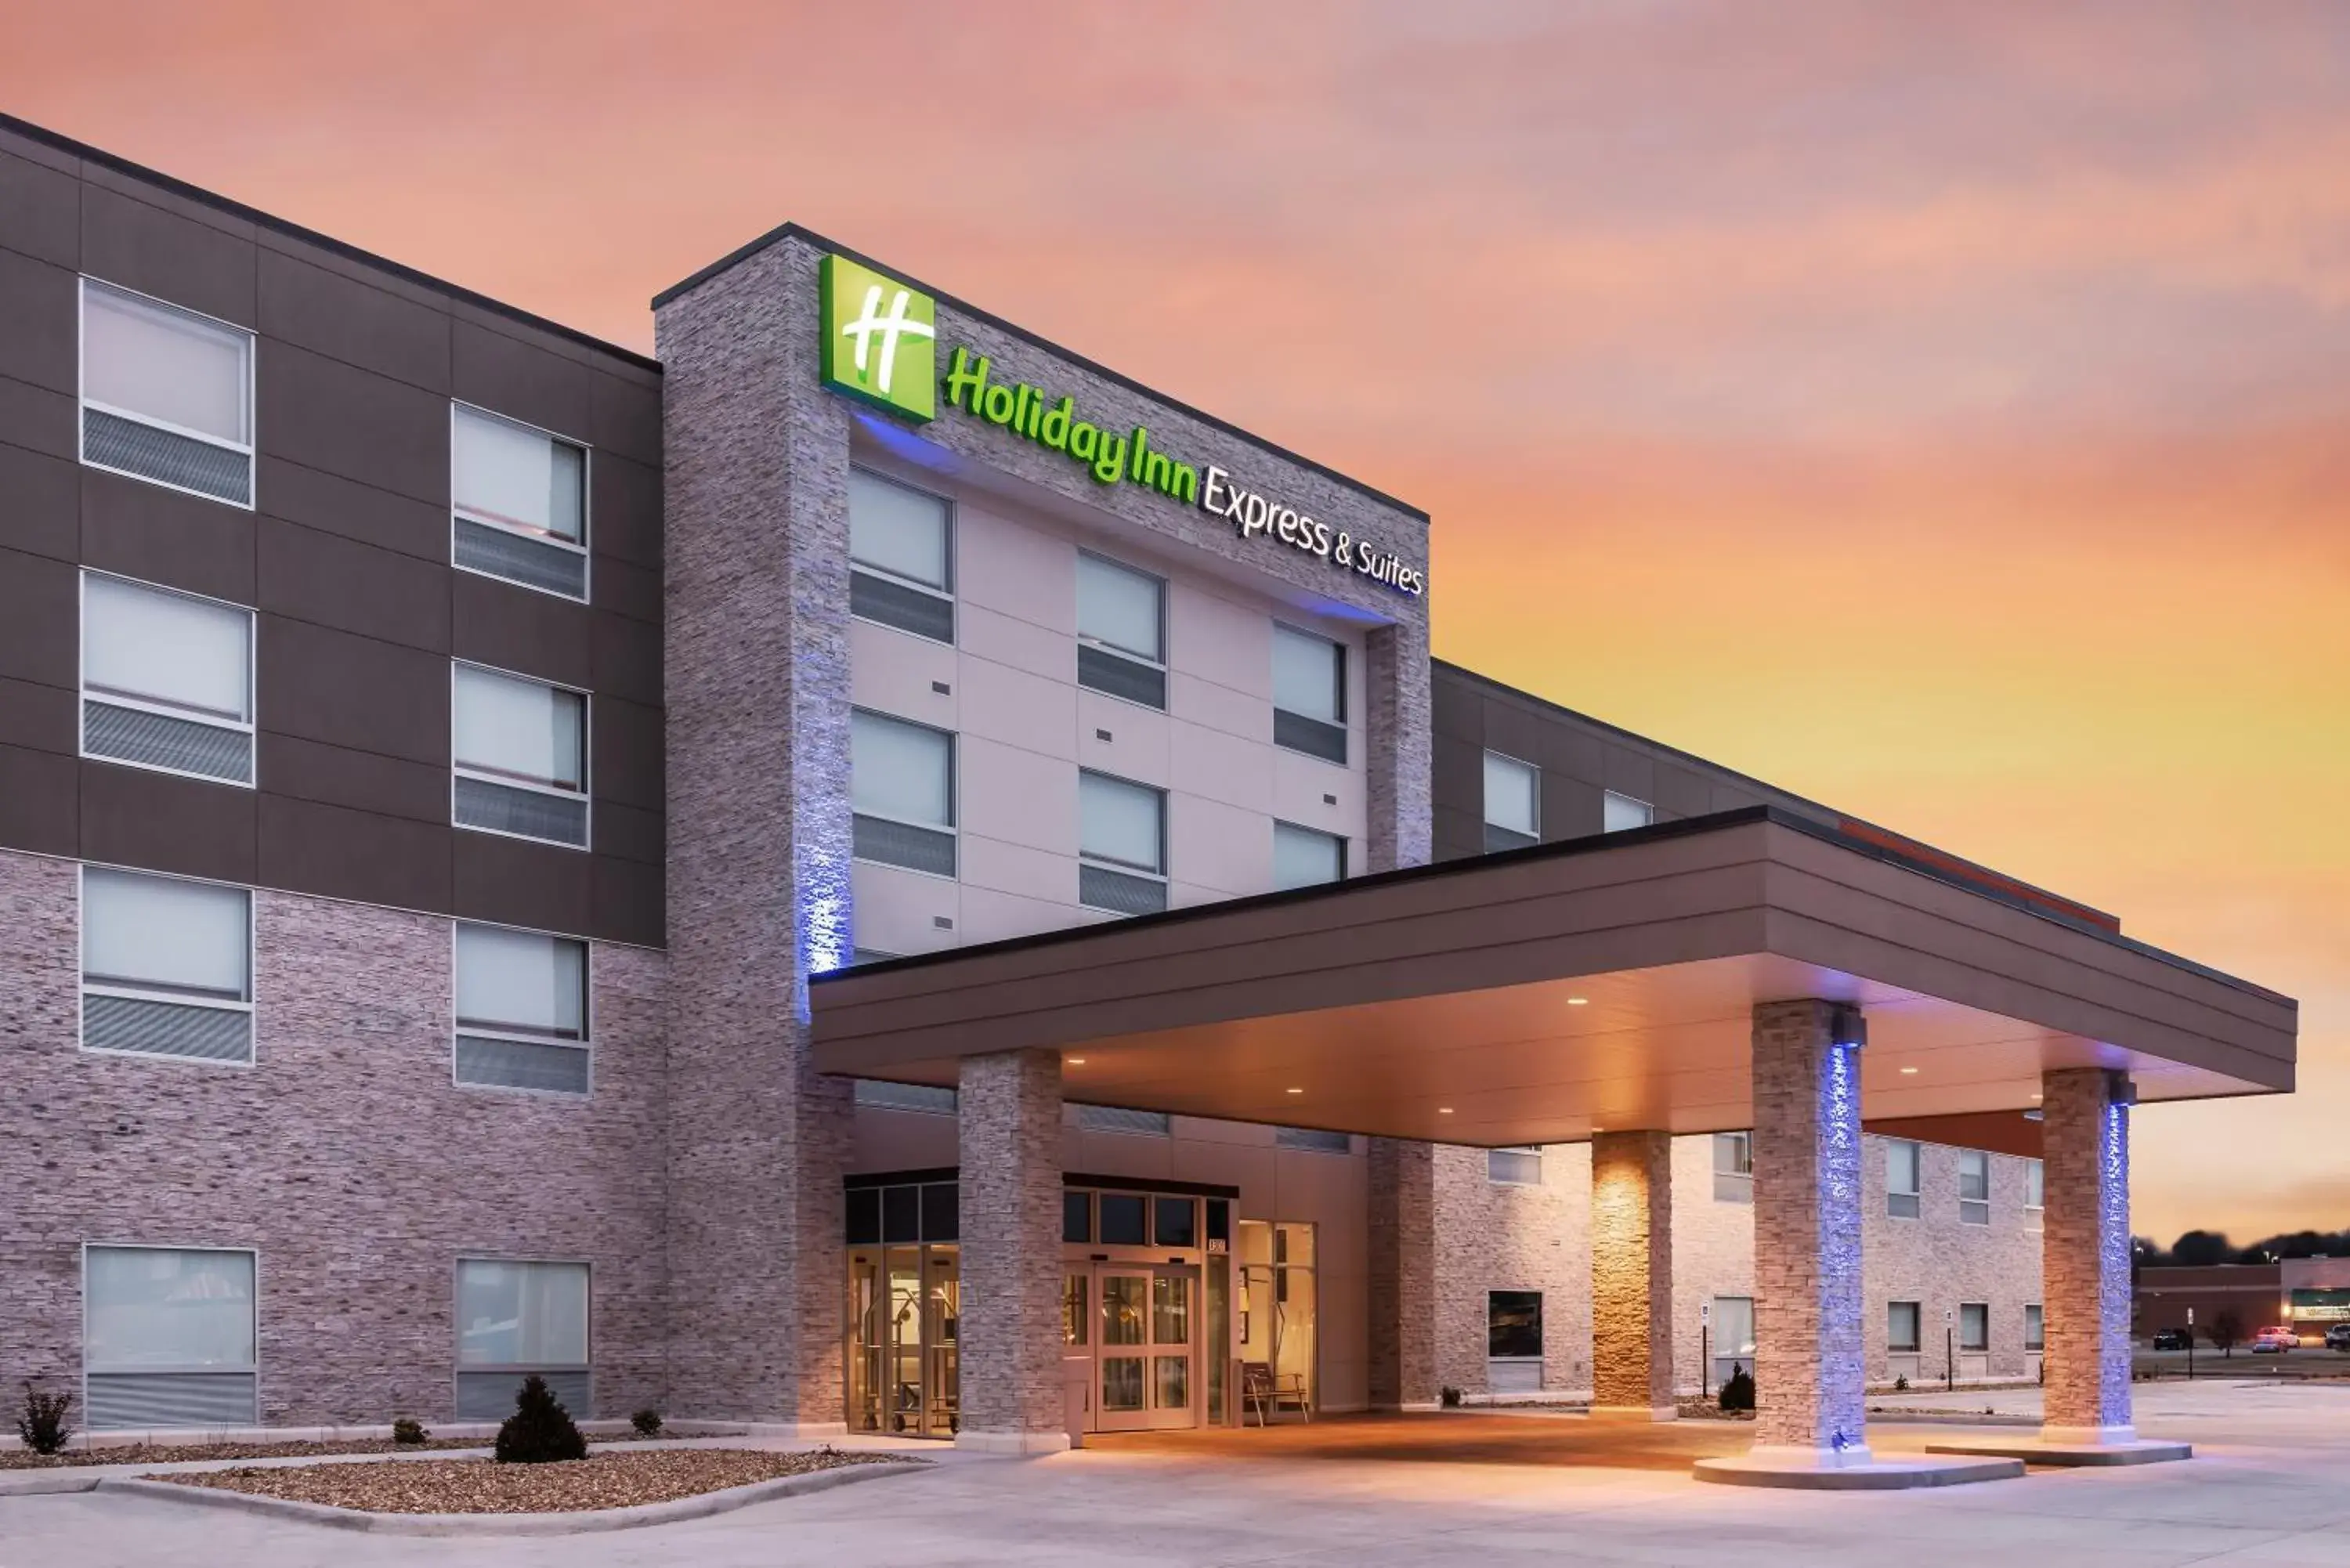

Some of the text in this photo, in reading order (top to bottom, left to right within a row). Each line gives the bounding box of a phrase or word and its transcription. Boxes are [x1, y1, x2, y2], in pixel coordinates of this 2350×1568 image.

[842, 285, 935, 394] H
[945, 347, 1423, 595] Holiday Inn Express & Suites
